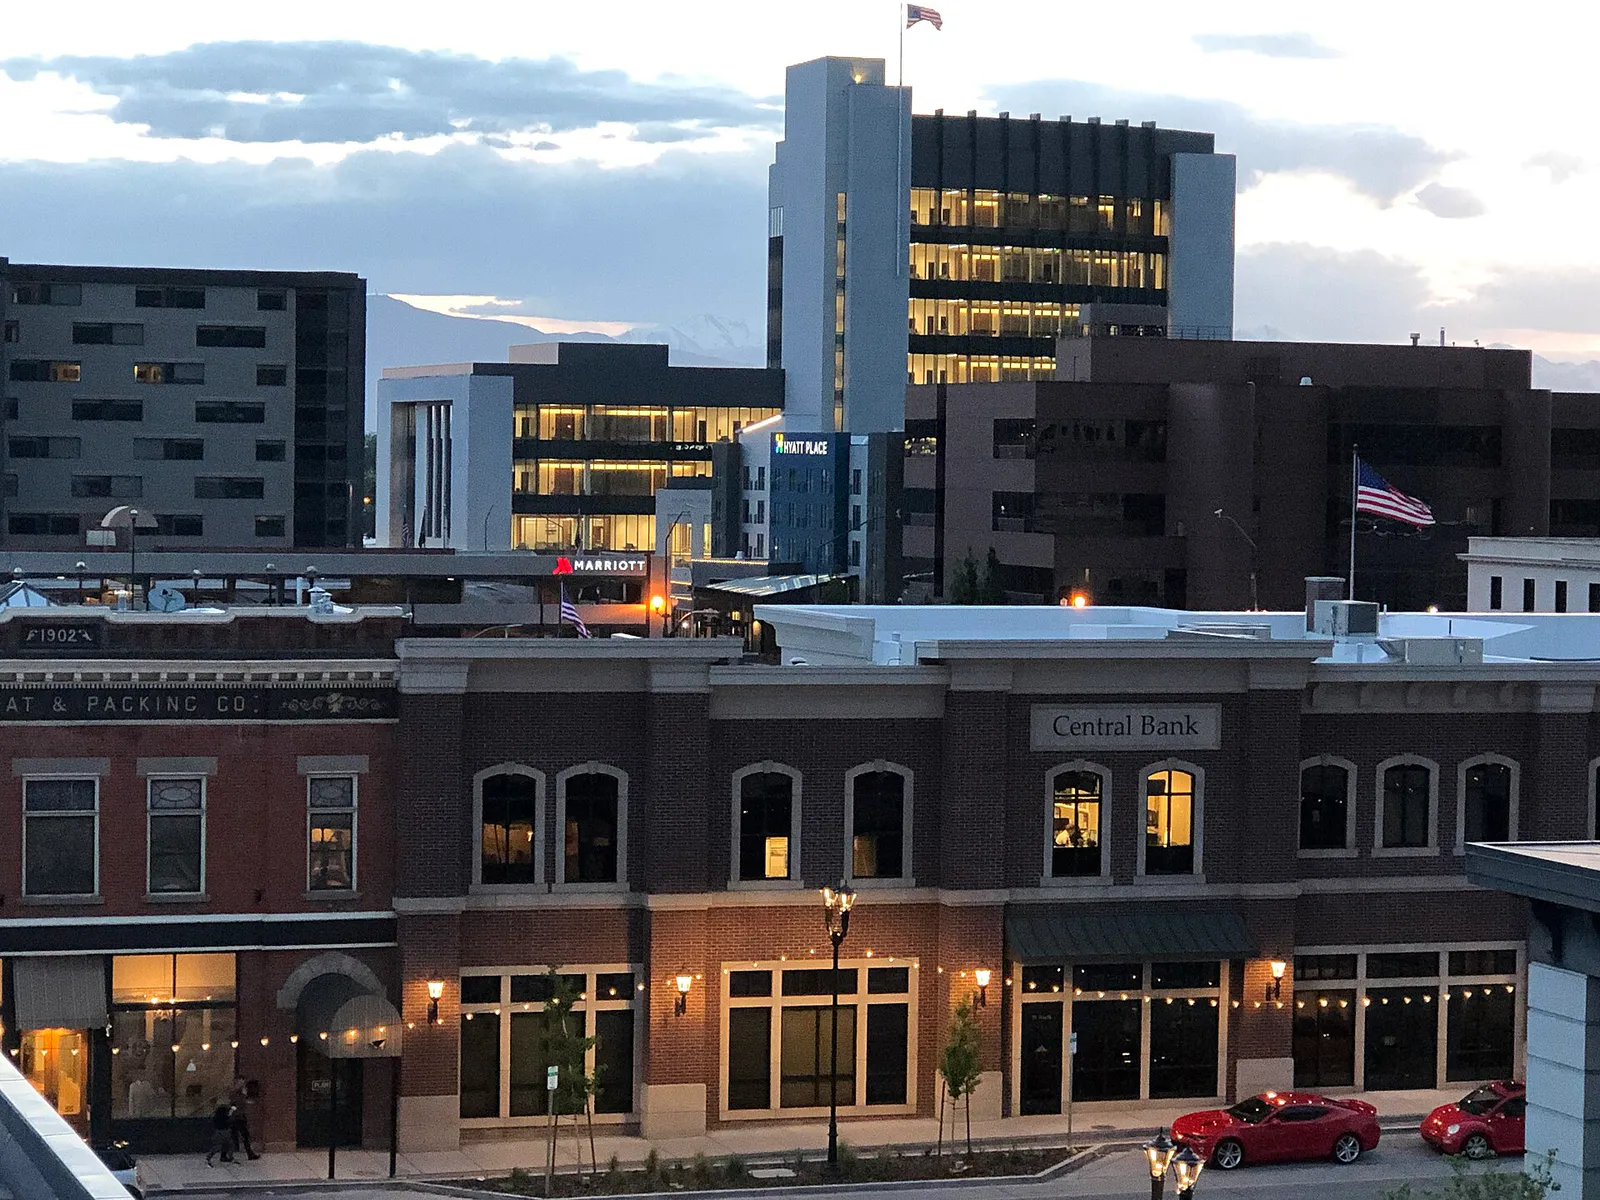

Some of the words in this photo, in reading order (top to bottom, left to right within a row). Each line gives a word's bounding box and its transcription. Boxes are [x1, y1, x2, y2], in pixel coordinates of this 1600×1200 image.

[783, 440, 805, 454] HYATT
[805, 440, 828, 455] PLACE
[574, 560, 646, 571] MARRIOTT
[40, 628, 77, 642] 1902
[6, 696, 34, 712] AT
[52, 696, 67, 712] &
[87, 696, 198, 712] PACKING
[1052, 714, 1131, 736] Central
[1141, 714, 1199, 736] Bank
